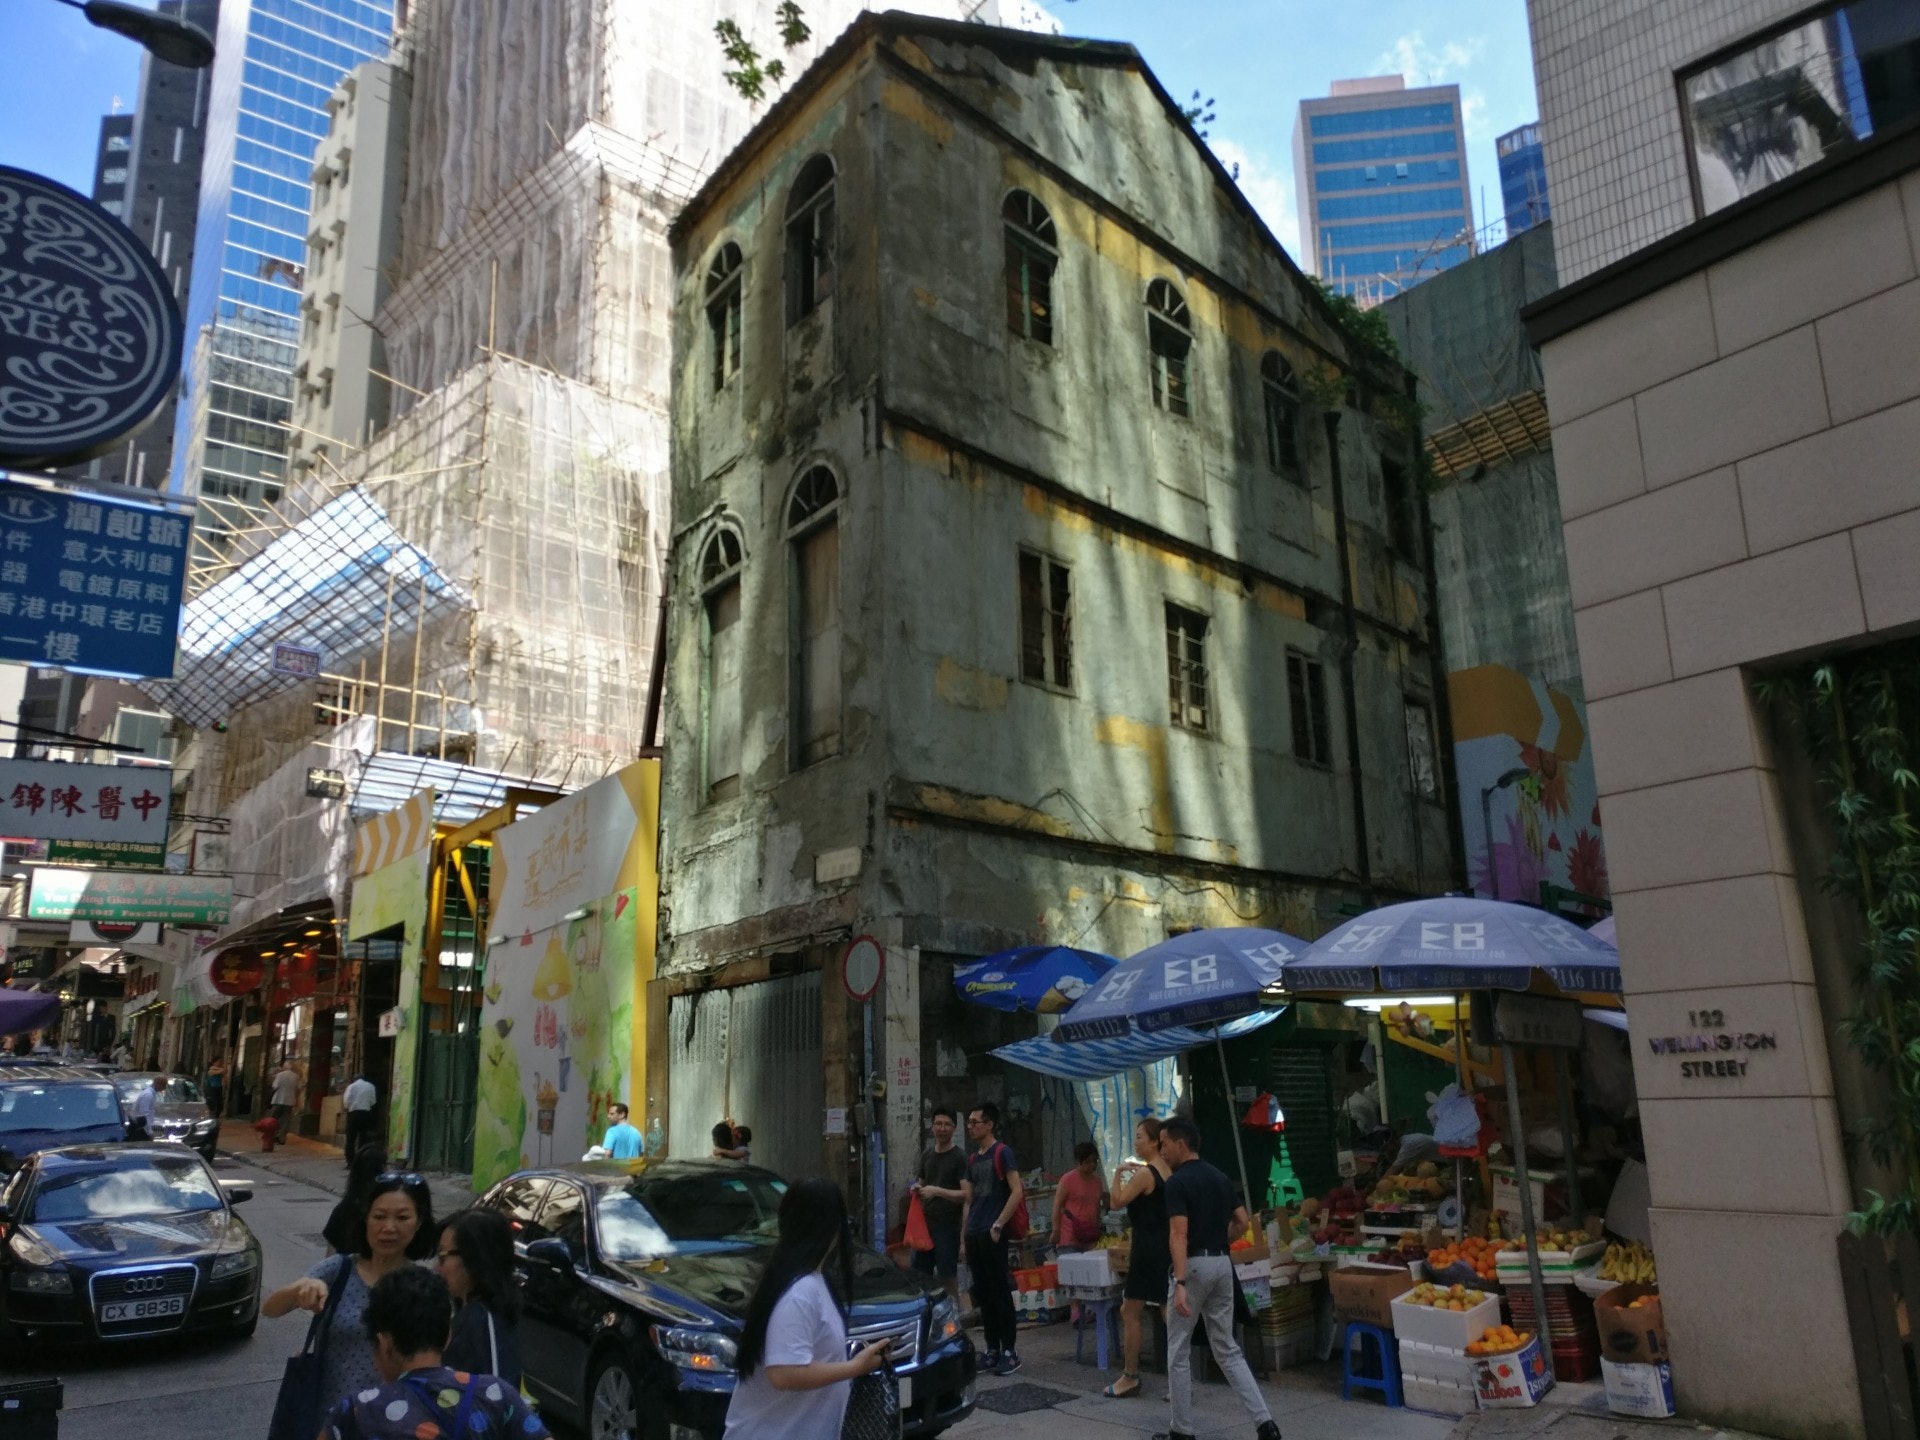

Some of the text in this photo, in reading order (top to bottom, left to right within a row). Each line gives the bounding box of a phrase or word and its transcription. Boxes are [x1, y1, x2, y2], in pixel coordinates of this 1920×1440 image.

[94, 842, 122, 852] GLASS
[129, 844, 162, 854] FRAMES
[1294, 968, 1328, 986] 2116
[1329, 969, 1365, 987] 1112
[1687, 1008, 1726, 1028] 122
[1070, 1019, 1121, 1040] 2116 1112
[1648, 1032, 1777, 1055] WELLINGTON
[1681, 1059, 1748, 1078] STREET
[105, 1304, 128, 1319] CX
